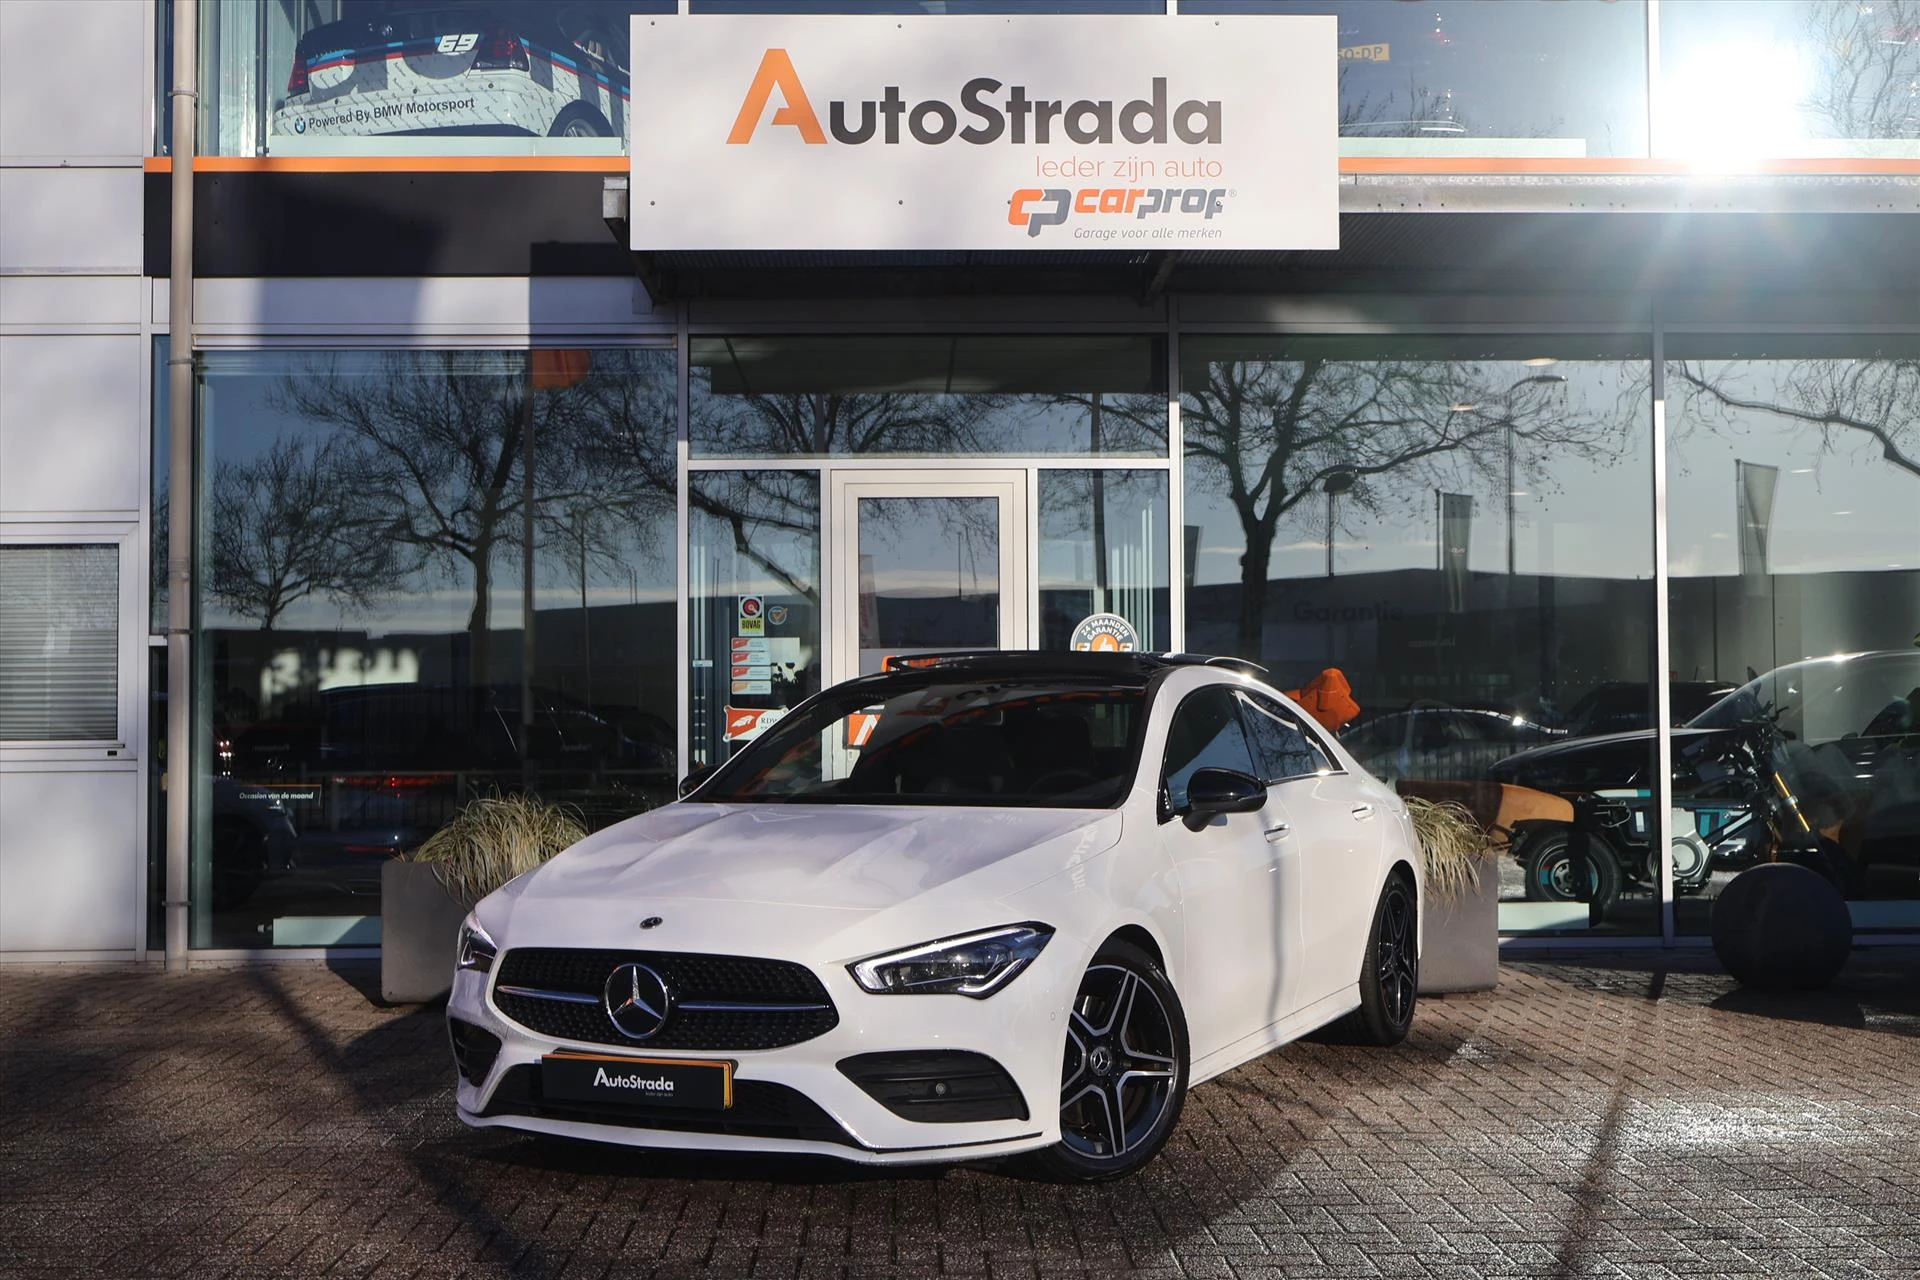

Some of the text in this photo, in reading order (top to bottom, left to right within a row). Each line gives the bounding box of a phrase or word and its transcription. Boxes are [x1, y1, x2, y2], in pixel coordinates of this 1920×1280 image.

[437, 33, 478, 53] 69
[726, 48, 1222, 146] AutoStrada
[308, 97, 476, 129] Powered By BMW Motorsport
[1036, 156, 1223, 183] Ieder zijn auto
[1074, 188, 1227, 219] carprof
[1074, 227, 1223, 241] Garage voor alle merken
[741, 619, 762, 630] BOVAG
[1087, 626, 1123, 641] GARANTIE
[1091, 619, 1129, 637] MAANDEN
[593, 1066, 675, 1092] AutoStrada
